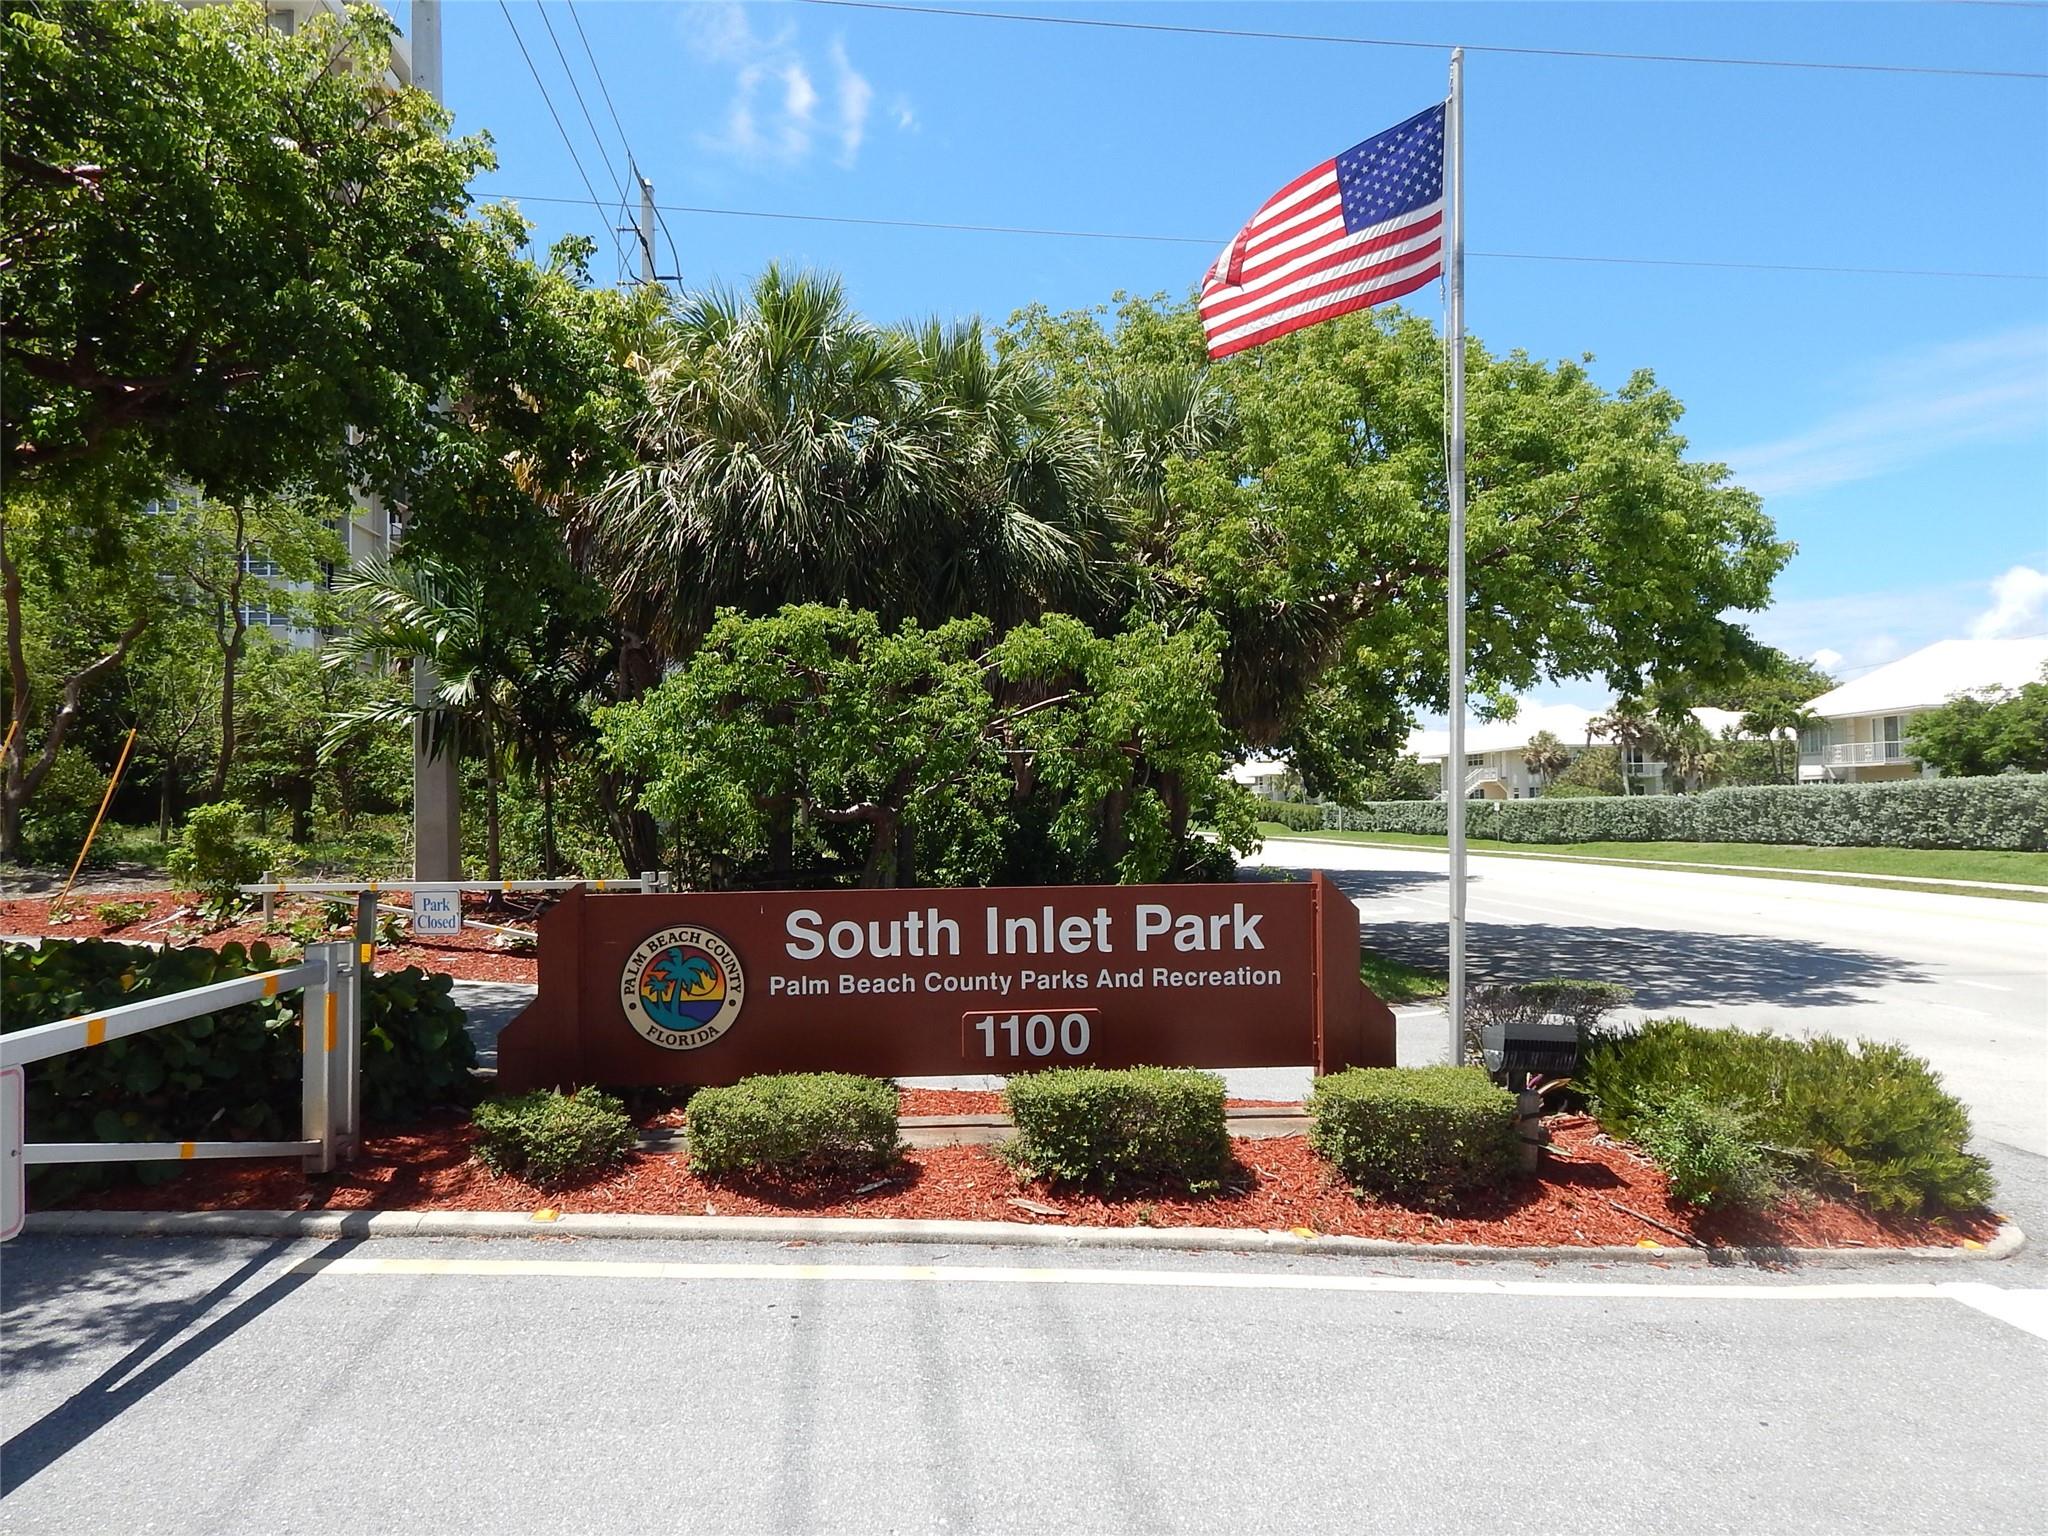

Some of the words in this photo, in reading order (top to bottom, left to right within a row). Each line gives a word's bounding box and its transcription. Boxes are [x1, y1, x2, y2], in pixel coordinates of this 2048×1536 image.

[423, 897, 450, 911] Park
[417, 914, 456, 929] Closed
[785, 907, 960, 960] South
[986, 905, 1113, 955] Inlet
[1135, 903, 1266, 952] Park
[624, 952, 648, 995] PALM
[646, 931, 702, 953] BEACH
[705, 938, 742, 993] COUNTY
[769, 976, 830, 996] Palm
[838, 973, 916, 994] Beach
[924, 972, 1012, 996] County
[1020, 969, 1089, 990] Parks
[1096, 968, 1144, 988] And
[1152, 966, 1281, 987] Recreation
[646, 1025, 720, 1046] FLORIDA
[975, 1012, 1091, 1057] 1100
